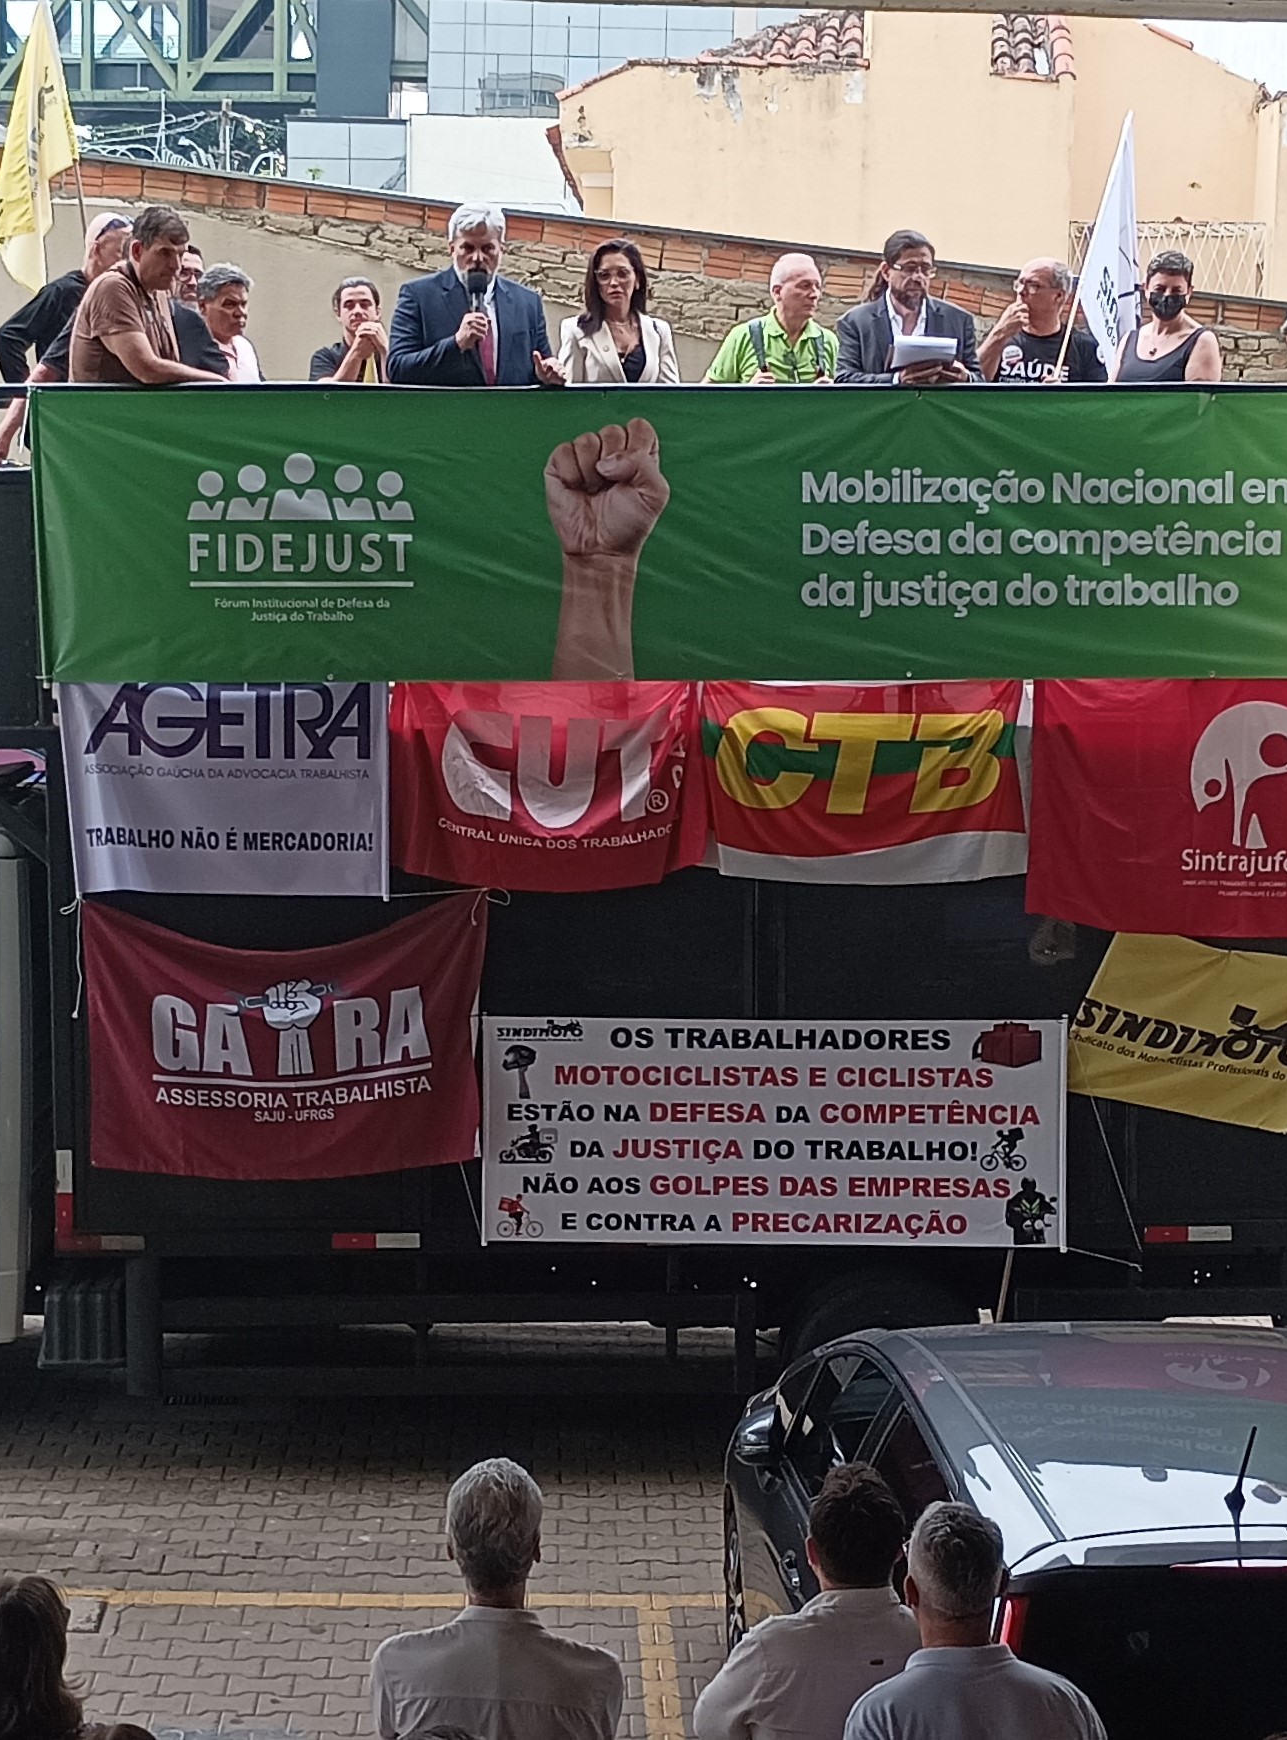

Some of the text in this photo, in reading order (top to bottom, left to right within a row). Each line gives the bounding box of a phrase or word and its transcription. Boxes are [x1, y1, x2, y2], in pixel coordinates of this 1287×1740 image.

[1000, 358, 1070, 382] SAÚDE
[801, 468, 1045, 514] Mobilização
[1052, 469, 1233, 504] Nacional
[188, 534, 413, 573] FIDEJUST
[801, 520, 1282, 566] Defesa da competência
[214, 598, 391, 609] Fórum Institucional de Defesa da
[801, 574, 1240, 617] da justiça do trabalho
[251, 611, 354, 623] Justiça do Trabalho
[83, 682, 372, 760] AGETRA
[84, 764, 370, 780] ASSOCIAÇÃO GAÚCHA DA ADVOCACIA TRABALHISTA
[441, 703, 671, 829] CUT
[715, 707, 1005, 815] CTB
[86, 826, 374, 852] TRABALHO NÃO É MERCADORIA!
[438, 817, 495, 842] CENTRAL
[546, 839, 577, 850] DOS
[609, 1027, 952, 1051] OS TRABALHADORES
[554, 1065, 994, 1088] MOTOCICLISTAS E CICLISTAS
[1116, 1045, 1136, 1058] dos
[1272, 1069, 1286, 1081] do
[155, 1076, 432, 1109] ASSESSORIA TRABALHISTA
[253, 1110, 285, 1123] SAJU
[295, 1109, 335, 1123] UFRGS
[506, 1099, 1040, 1125] ESTÃO NA DEFESA DA COMPETÊNCIA
[570, 1138, 979, 1165] DA JUSTIÇA DO TRABALHO!
[522, 1172, 1012, 1198] NÃO AOS GOLPES DAS EMPRESAS
[561, 1209, 968, 1239] E CONTRA A PRECARIZAÇÃO
